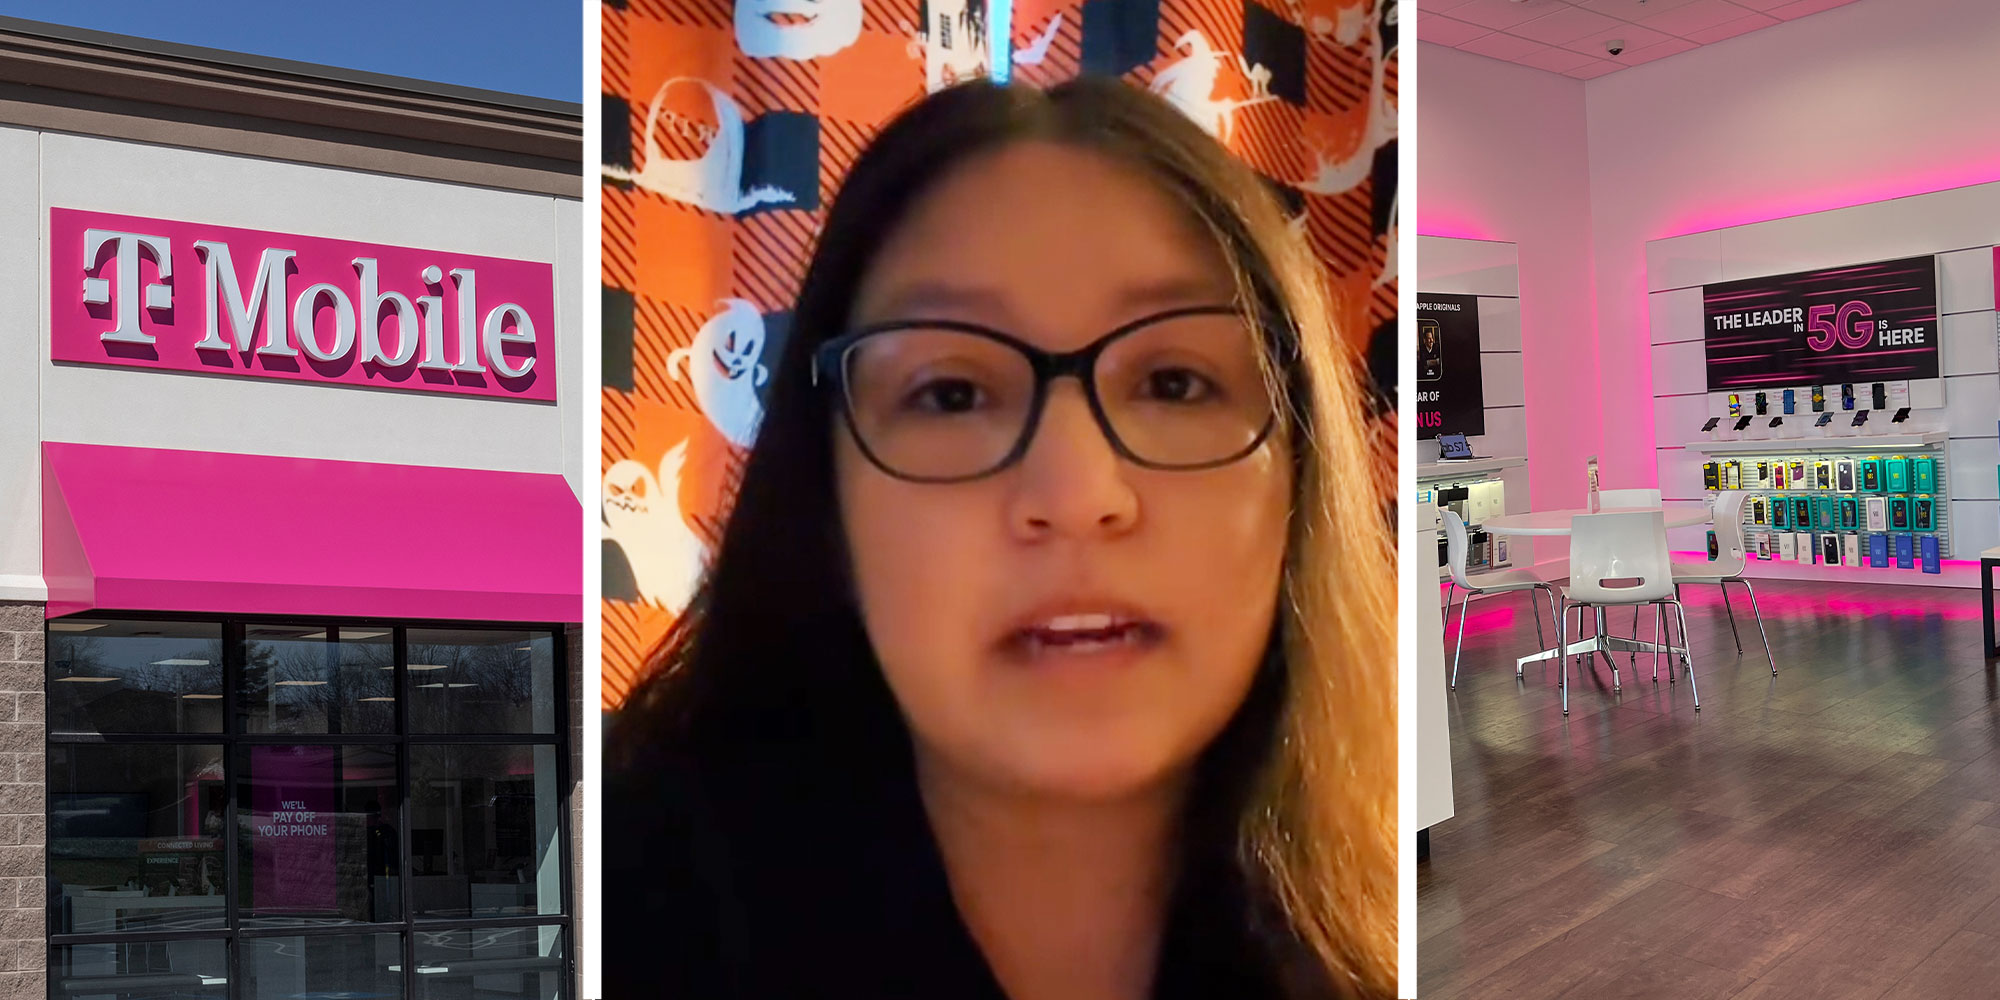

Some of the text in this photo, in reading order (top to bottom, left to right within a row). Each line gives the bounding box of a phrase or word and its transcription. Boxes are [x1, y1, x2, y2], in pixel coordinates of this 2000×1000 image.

[193, 240, 537, 379] Mobile
[1416, 302, 1461, 312] APPLE ORIGINALS
[1713, 307, 1803, 331] THE LEADER
[1878, 319, 1889, 330] IS
[1794, 323, 1804, 332] IN
[1807, 300, 1874, 352] 5G
[1879, 327, 1925, 346] HERE
[1429, 391, 1440, 402] OF
[1425, 411, 1442, 427] US
[281, 800, 306, 810] WE'LL
[273, 811, 316, 823] PAY OFF
[258, 824, 327, 837] YOUR PHONE
[157, 841, 194, 849] CONNECTED
